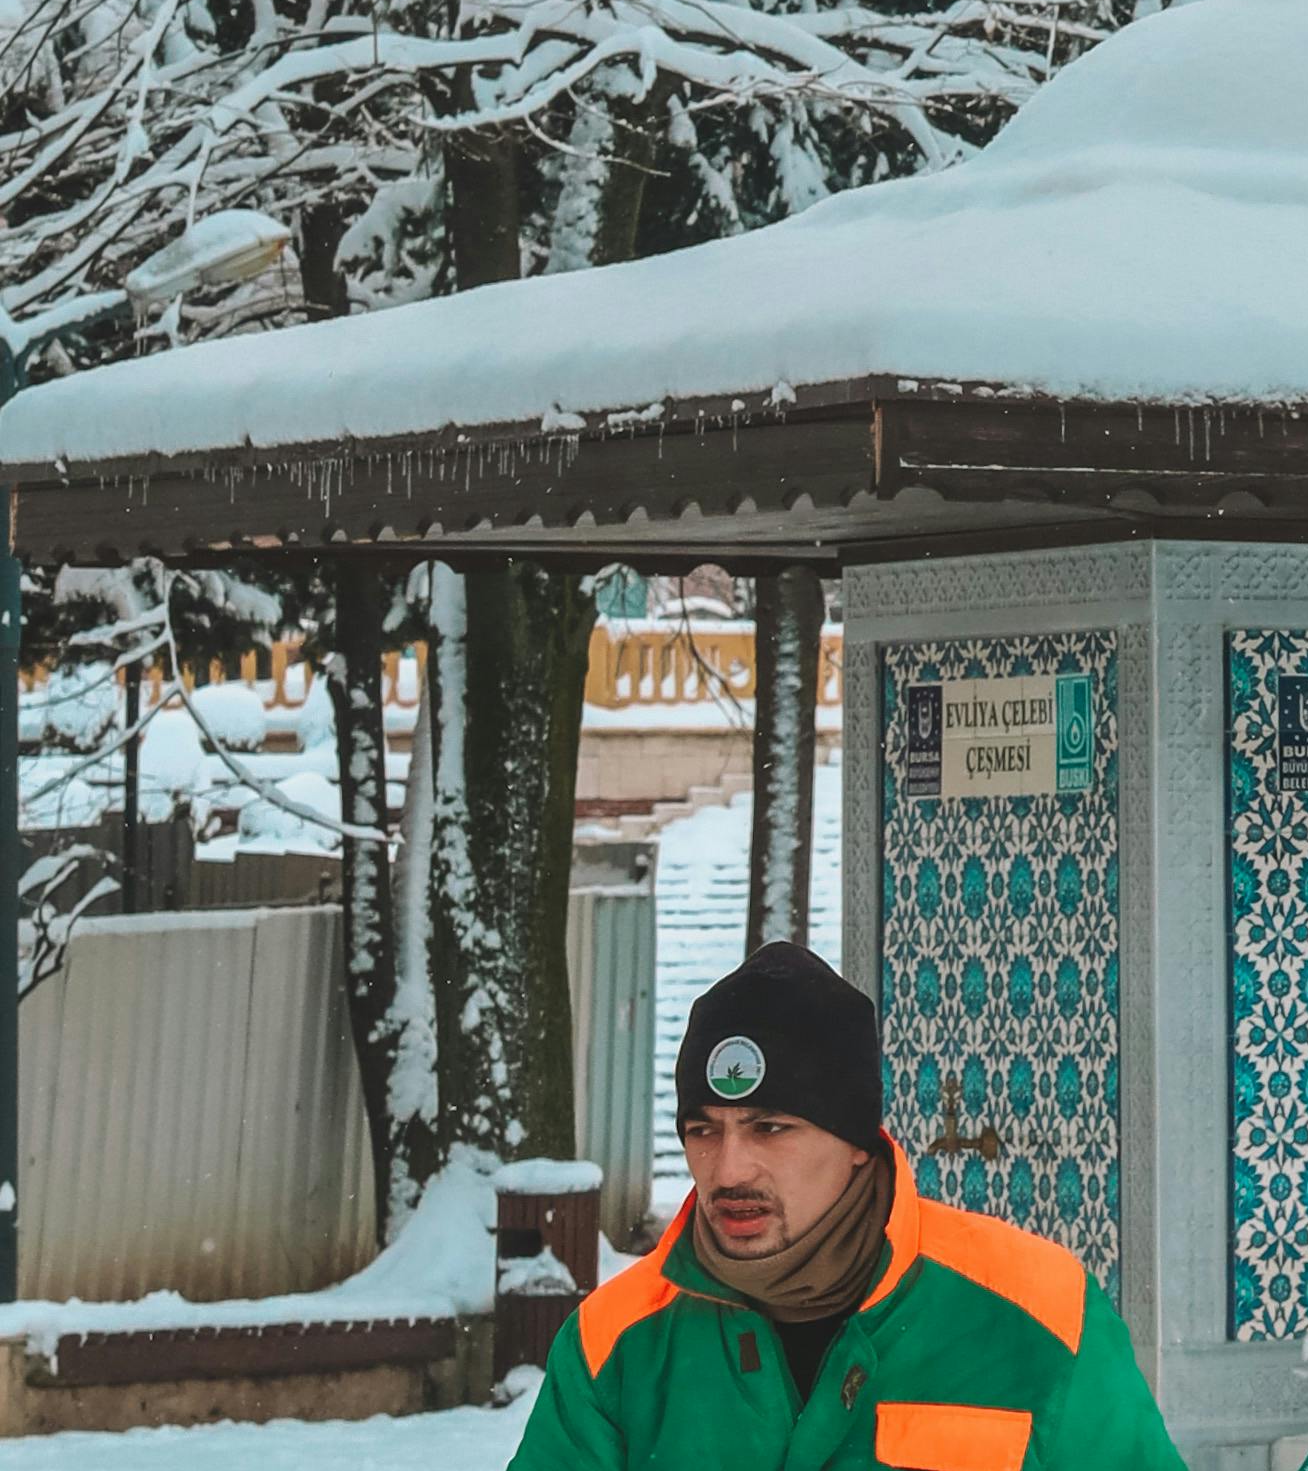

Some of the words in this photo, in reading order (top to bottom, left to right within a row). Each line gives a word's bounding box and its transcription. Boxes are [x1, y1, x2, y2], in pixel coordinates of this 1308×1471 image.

[946, 696, 999, 729] EVLİYA
[1002, 692, 1053, 733] ÇELEBİ
[966, 738, 1031, 780] ÇEŞMESİ
